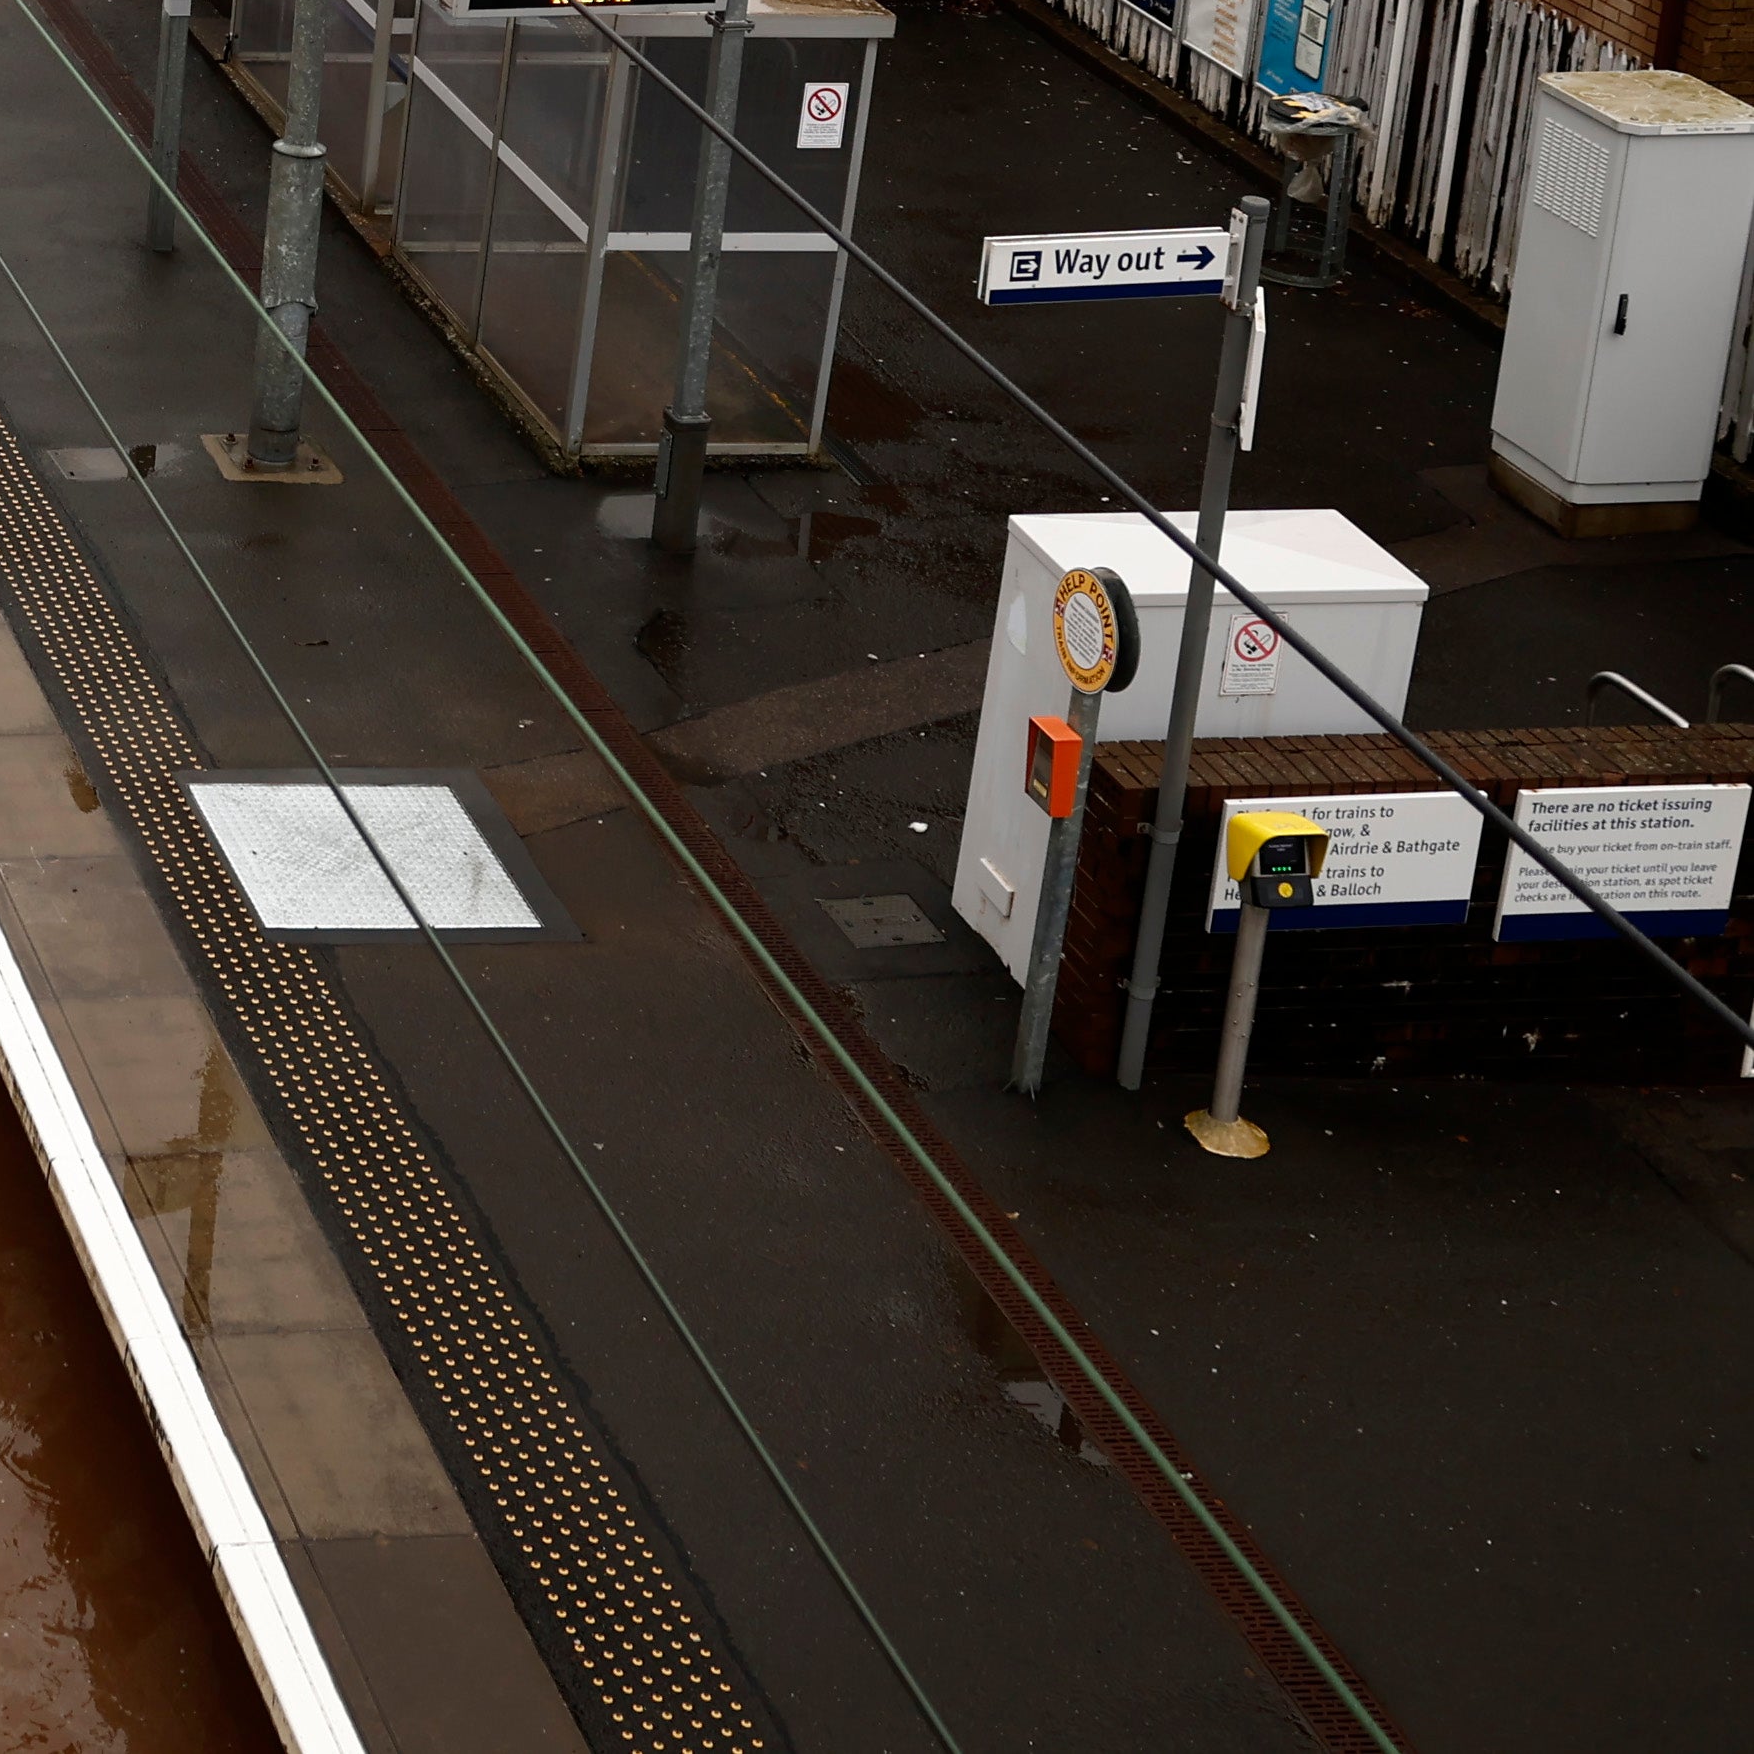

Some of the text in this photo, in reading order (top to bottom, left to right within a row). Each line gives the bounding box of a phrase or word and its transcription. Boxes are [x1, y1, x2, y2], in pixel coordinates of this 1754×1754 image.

[1054, 246, 1166, 280] Way out
[1059, 573, 1086, 602] HELP
[1089, 581, 1114, 642] POINT
[1312, 807, 1332, 820] for
[1335, 806, 1376, 819] trains
[1380, 807, 1394, 818] to
[1532, 798, 1712, 814] There are no ticket issuing
[1360, 824, 1371, 837] &
[1528, 816, 1695, 833] facilities at this station.
[1330, 840, 1460, 855] Airdrie & Bathgate
[1557, 843, 1575, 856] buy
[1577, 844, 1600, 857] your
[1602, 842, 1632, 852] ticket
[1634, 841, 1658, 851] from
[1660, 840, 1702, 850] on-train
[1705, 840, 1732, 850] staff.
[1326, 866, 1385, 879] trains to
[1586, 862, 1718, 878] your ticket until you leave
[1316, 882, 1382, 897] & Balloch
[1516, 875, 1713, 891] your station, as spot ticket
[1514, 892, 1548, 902] checks
[1550, 892, 1566, 902] are
[1634, 890, 1646, 899] on
[1649, 888, 1669, 898] this
[1671, 888, 1702, 898] route.
